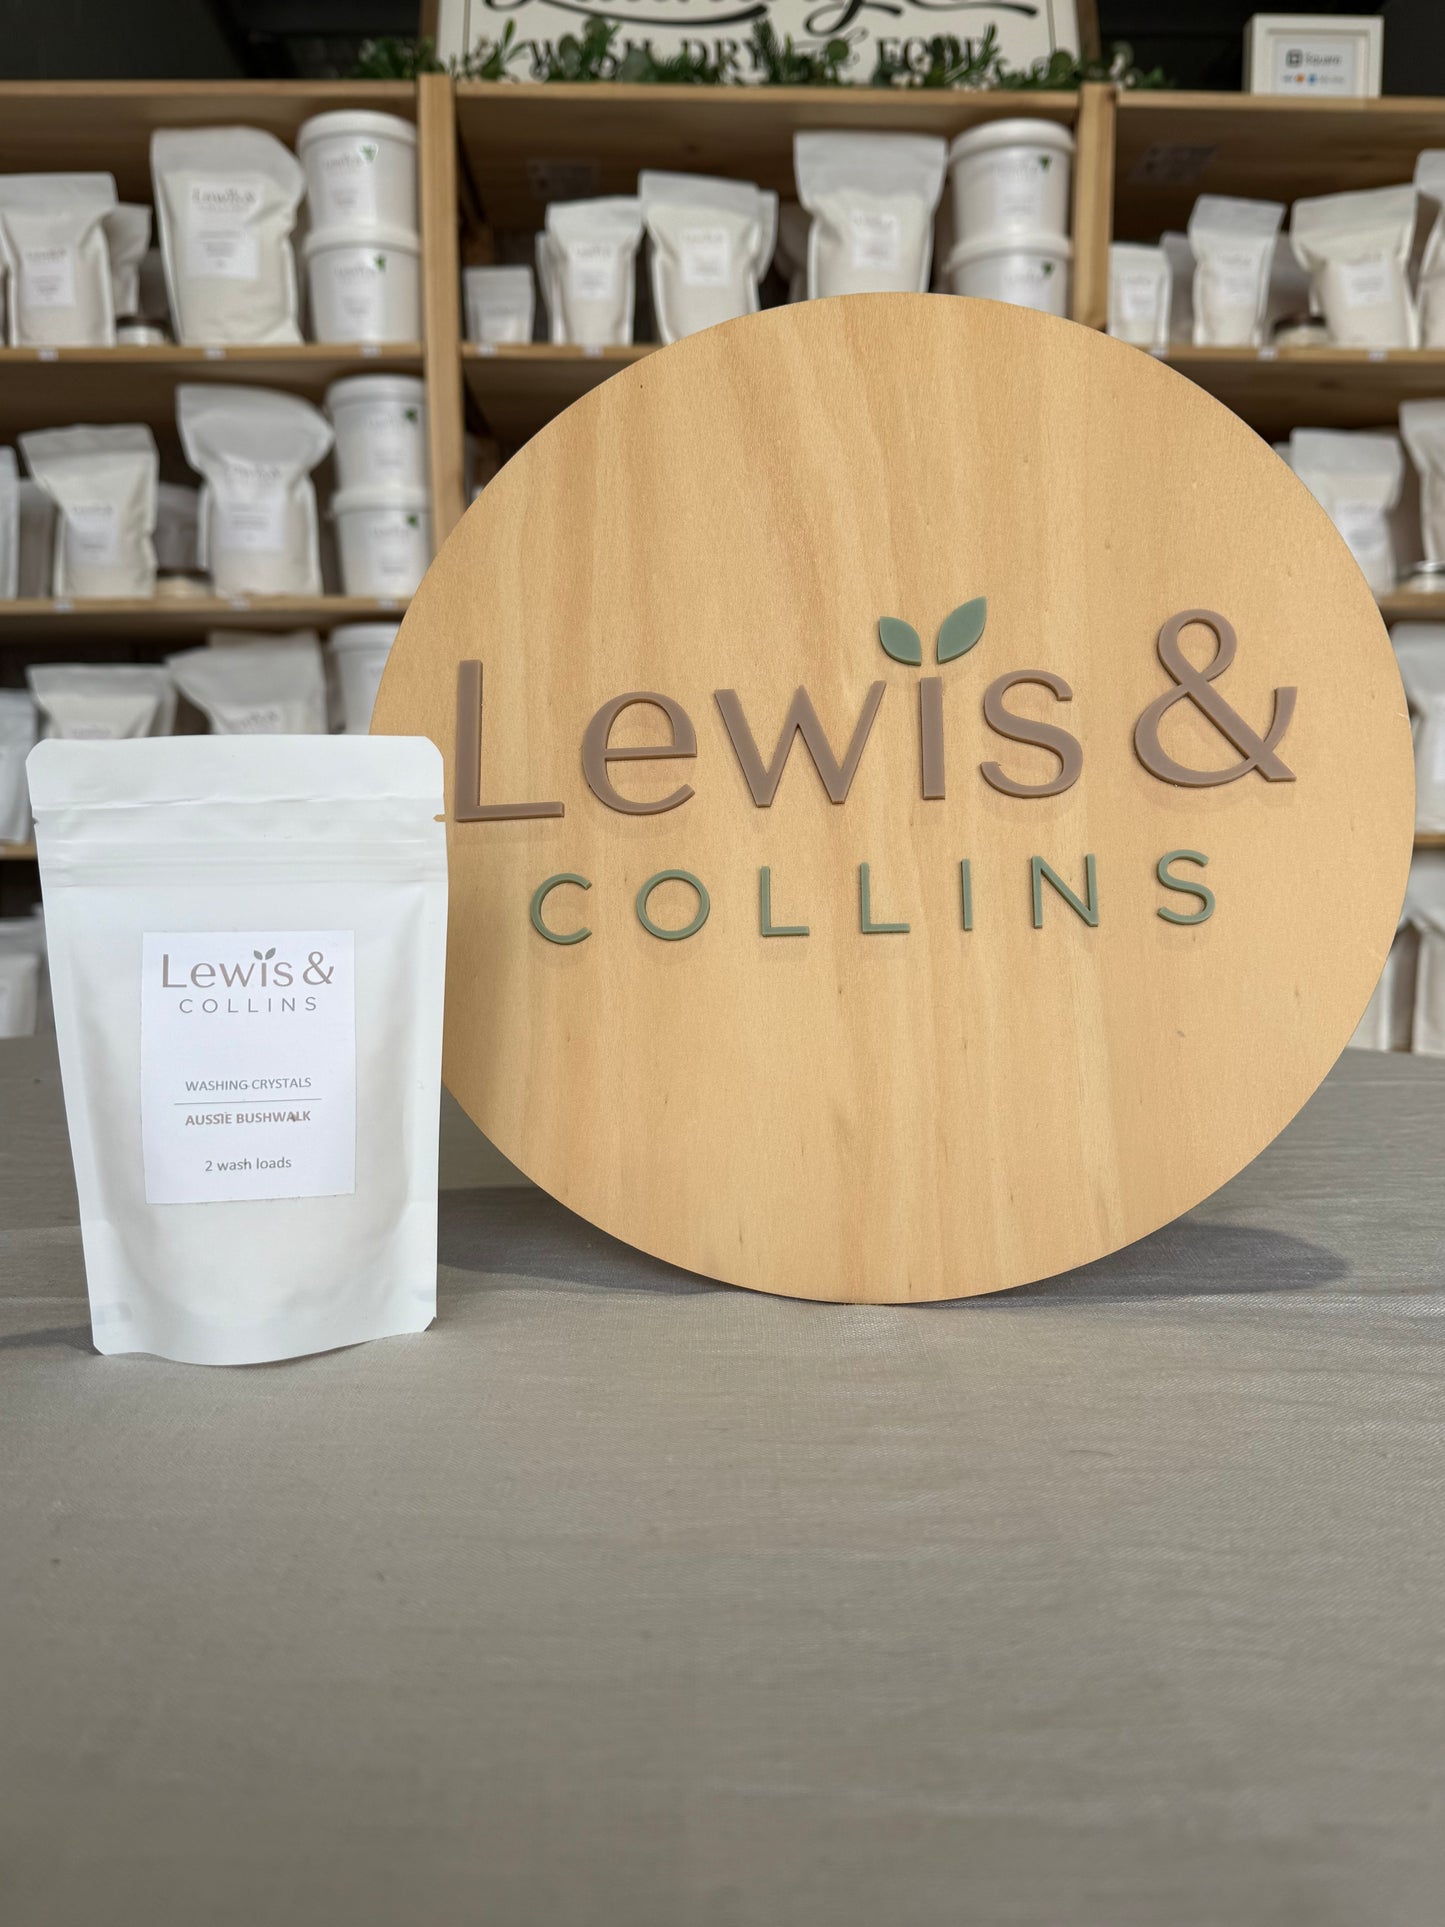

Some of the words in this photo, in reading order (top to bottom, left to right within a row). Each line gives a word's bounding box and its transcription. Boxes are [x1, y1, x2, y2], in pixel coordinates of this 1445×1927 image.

[455, 597, 1084, 823] Lewis
[1133, 608, 1298, 788] &
[530, 849, 1216, 946] COLLINS
[162, 948, 294, 988] Lewis
[302, 951, 335, 985] &
[179, 996, 317, 1014] COLLINS
[185, 1079, 248, 1092] WASHING
[251, 1077, 312, 1090] CRYSTALS
[185, 1113, 232, 1126] AUSSIE
[236, 1110, 311, 1125] BUSHWALK
[205, 1160, 213, 1172] 2
[217, 1158, 252, 1171] wash
[256, 1156, 292, 1169] loads
